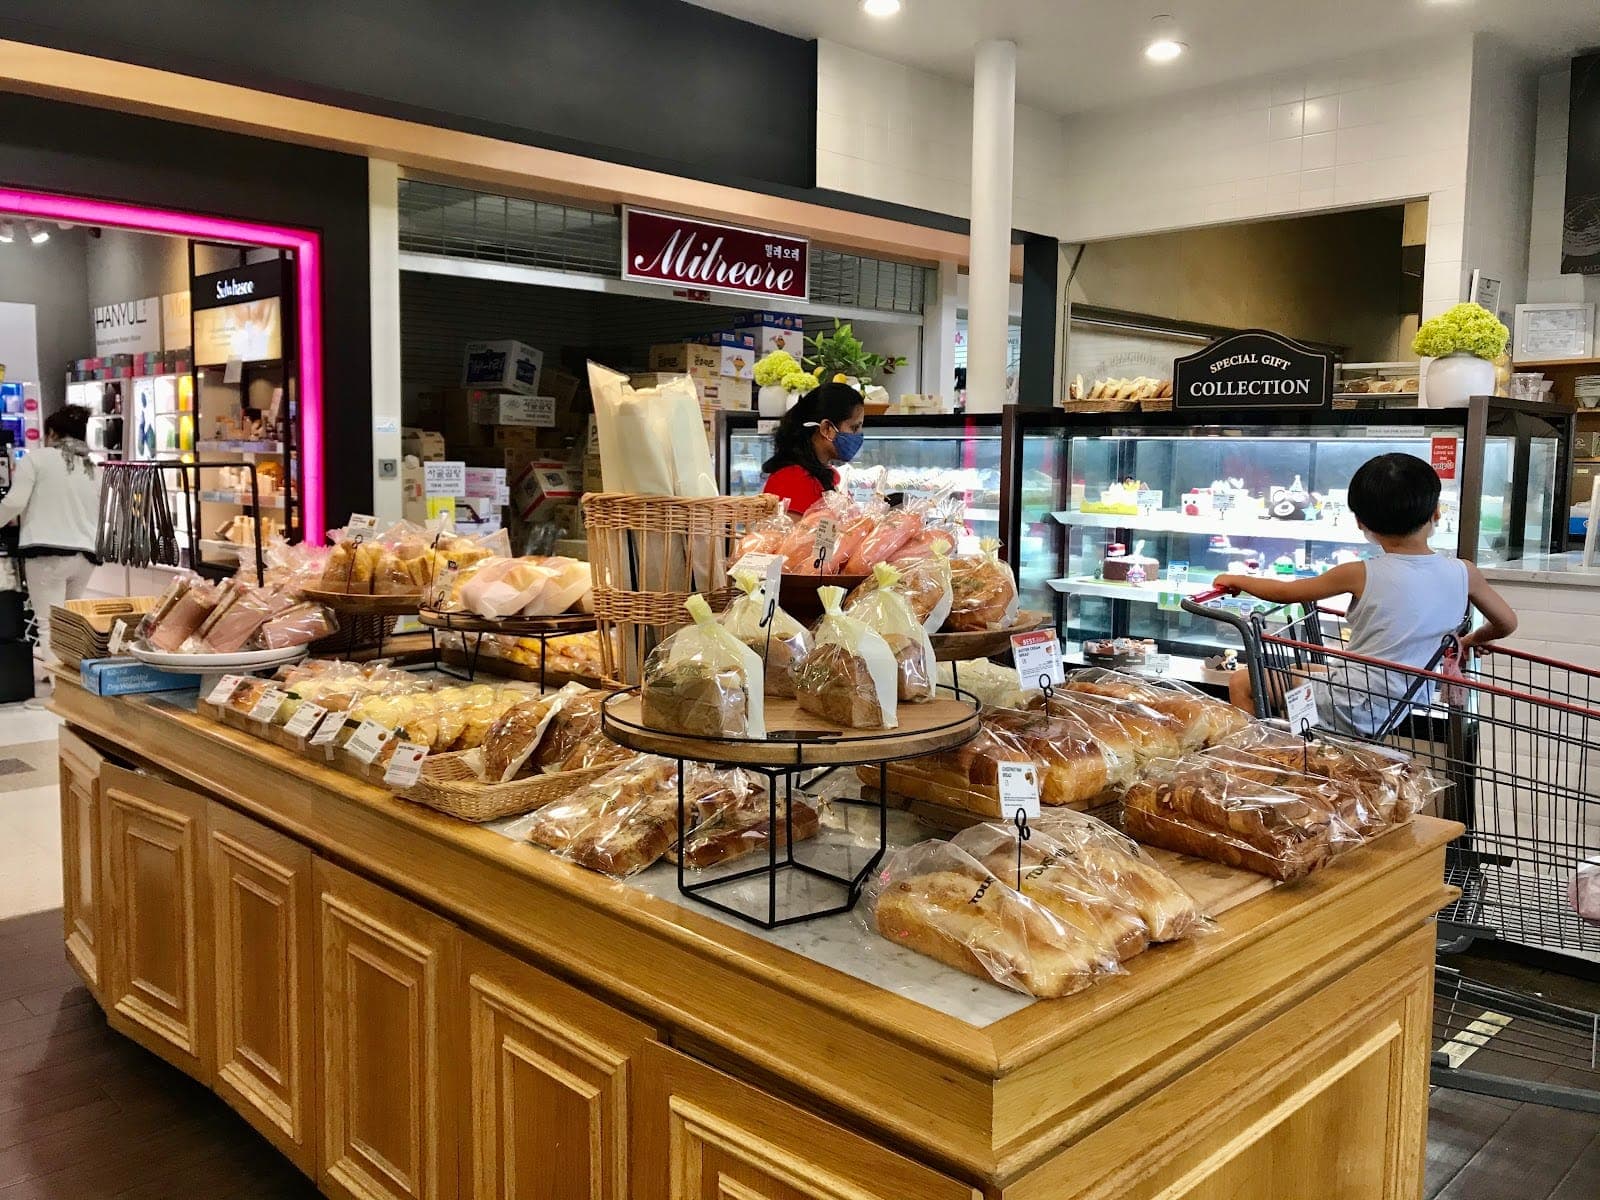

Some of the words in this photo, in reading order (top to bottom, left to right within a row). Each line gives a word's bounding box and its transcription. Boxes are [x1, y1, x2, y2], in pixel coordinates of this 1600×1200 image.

[634, 228, 794, 291] Milreore
[95, 299, 147, 330] HANYUL
[1209, 353, 1258, 374] SPECIAL
[1261, 354, 1292, 371] GIFT
[1189, 378, 1311, 397] COLLECTION
